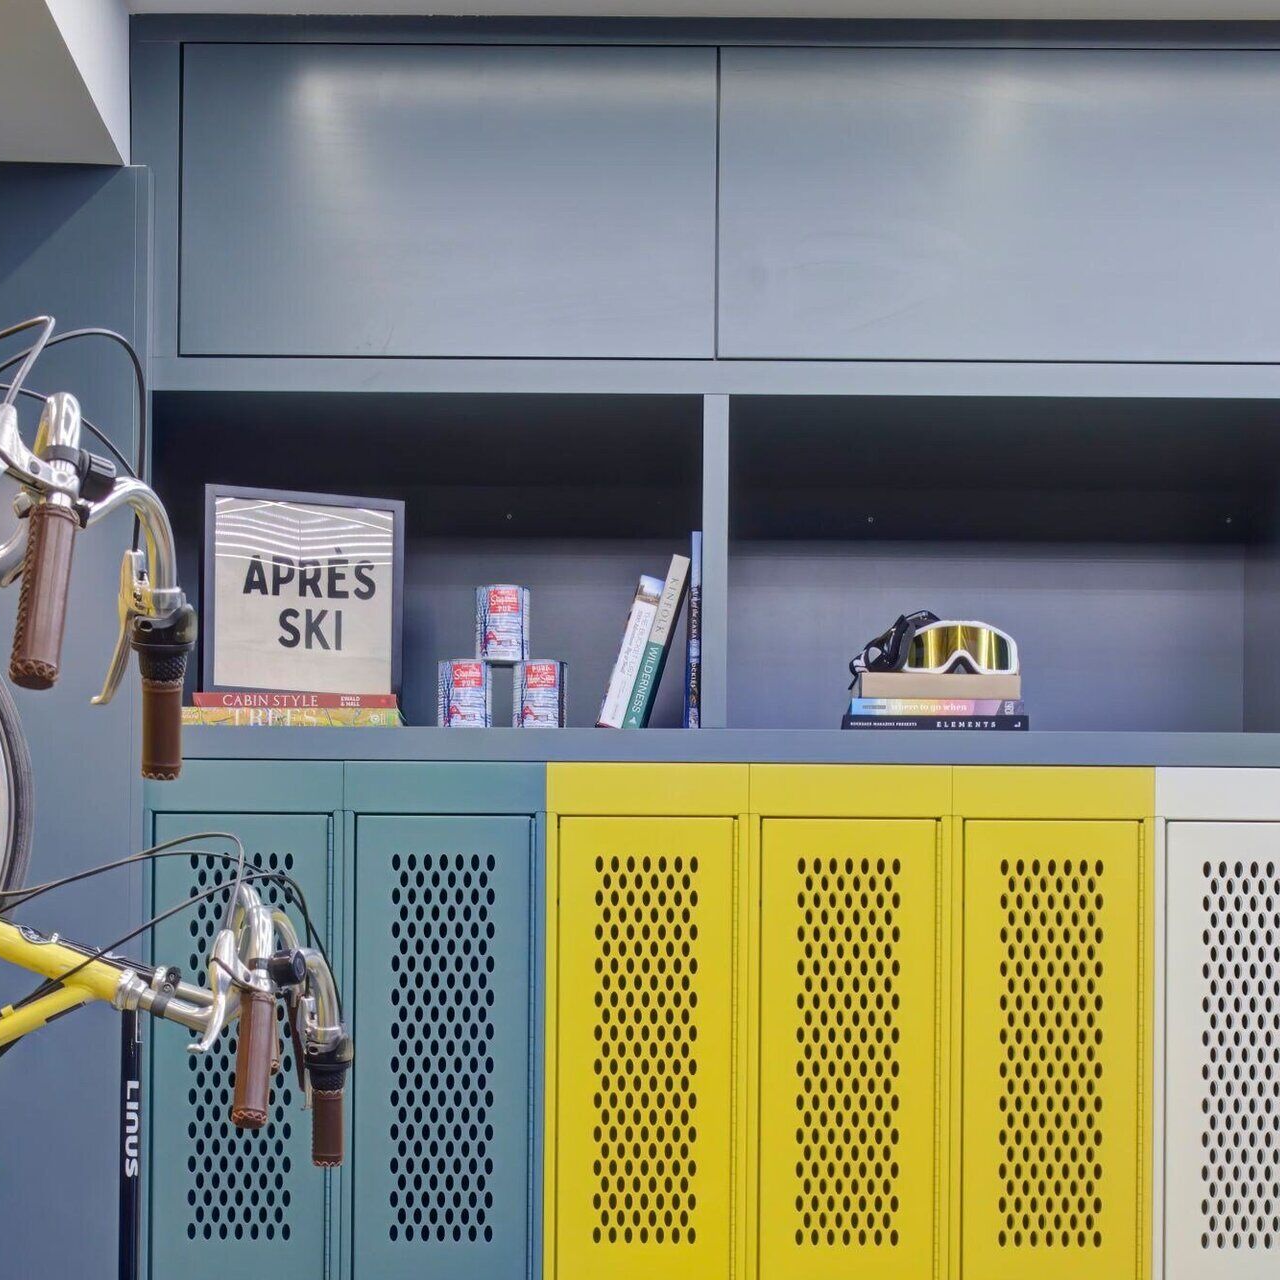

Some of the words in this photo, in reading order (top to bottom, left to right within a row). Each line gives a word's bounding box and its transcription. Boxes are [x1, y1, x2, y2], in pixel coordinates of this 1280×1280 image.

[243, 547, 376, 600] APRÈS
[278, 608, 342, 650] SKI
[655, 577, 679, 634] KINFOLK
[222, 694, 269, 707] CABIN
[273, 694, 319, 707] STYLE
[632, 646, 659, 713] WILDERNESS
[943, 702, 967, 712] when
[125, 1080, 140, 1178] LINUS
